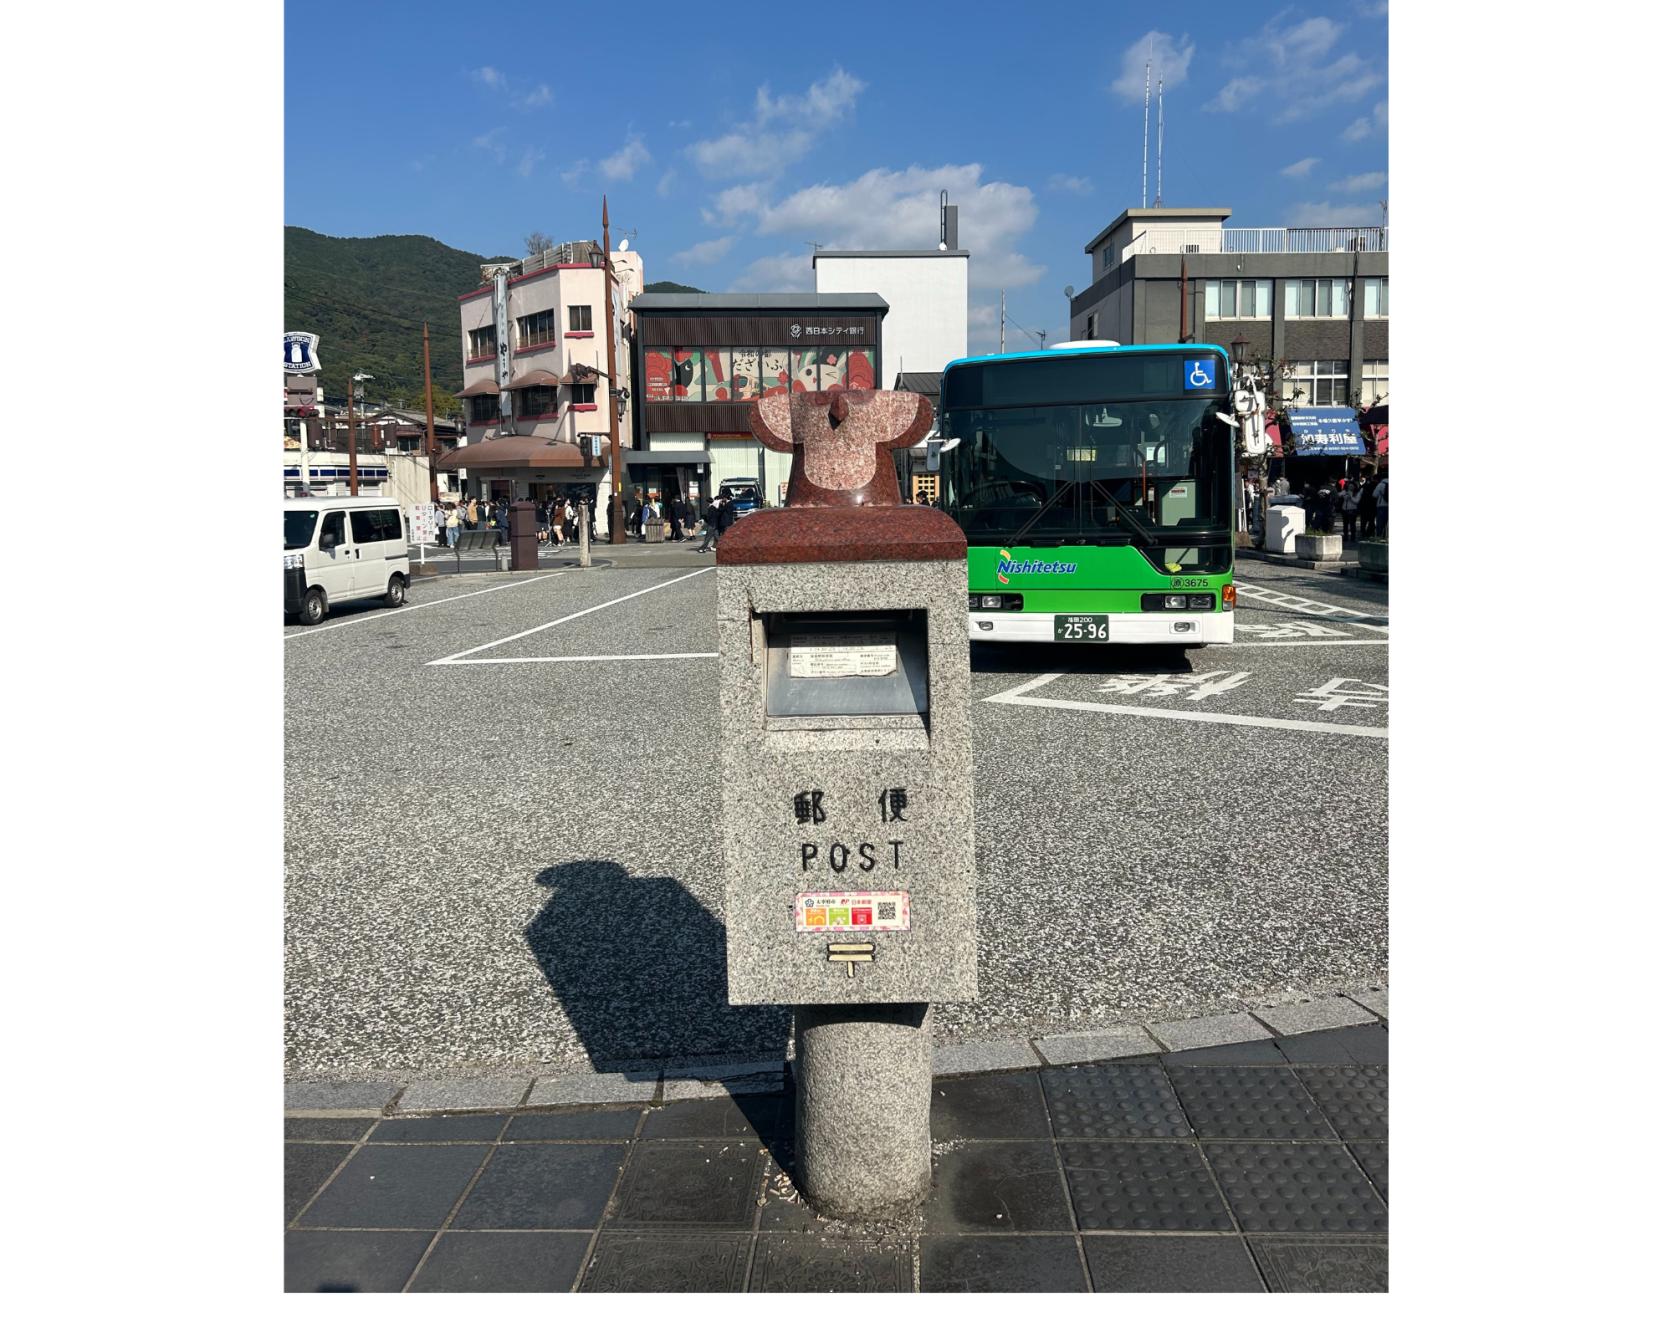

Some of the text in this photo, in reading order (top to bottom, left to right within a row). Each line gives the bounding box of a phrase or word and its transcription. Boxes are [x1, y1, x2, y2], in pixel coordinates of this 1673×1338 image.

[805, 326, 865, 336] 西日本シティ銀行
[997, 559, 1077, 574] Nishitetsu
[1184, 578, 1209, 588] 3675
[1064, 623, 1107, 639] 25-96
[793, 788, 908, 825] 郵便
[802, 841, 903, 873] POST
